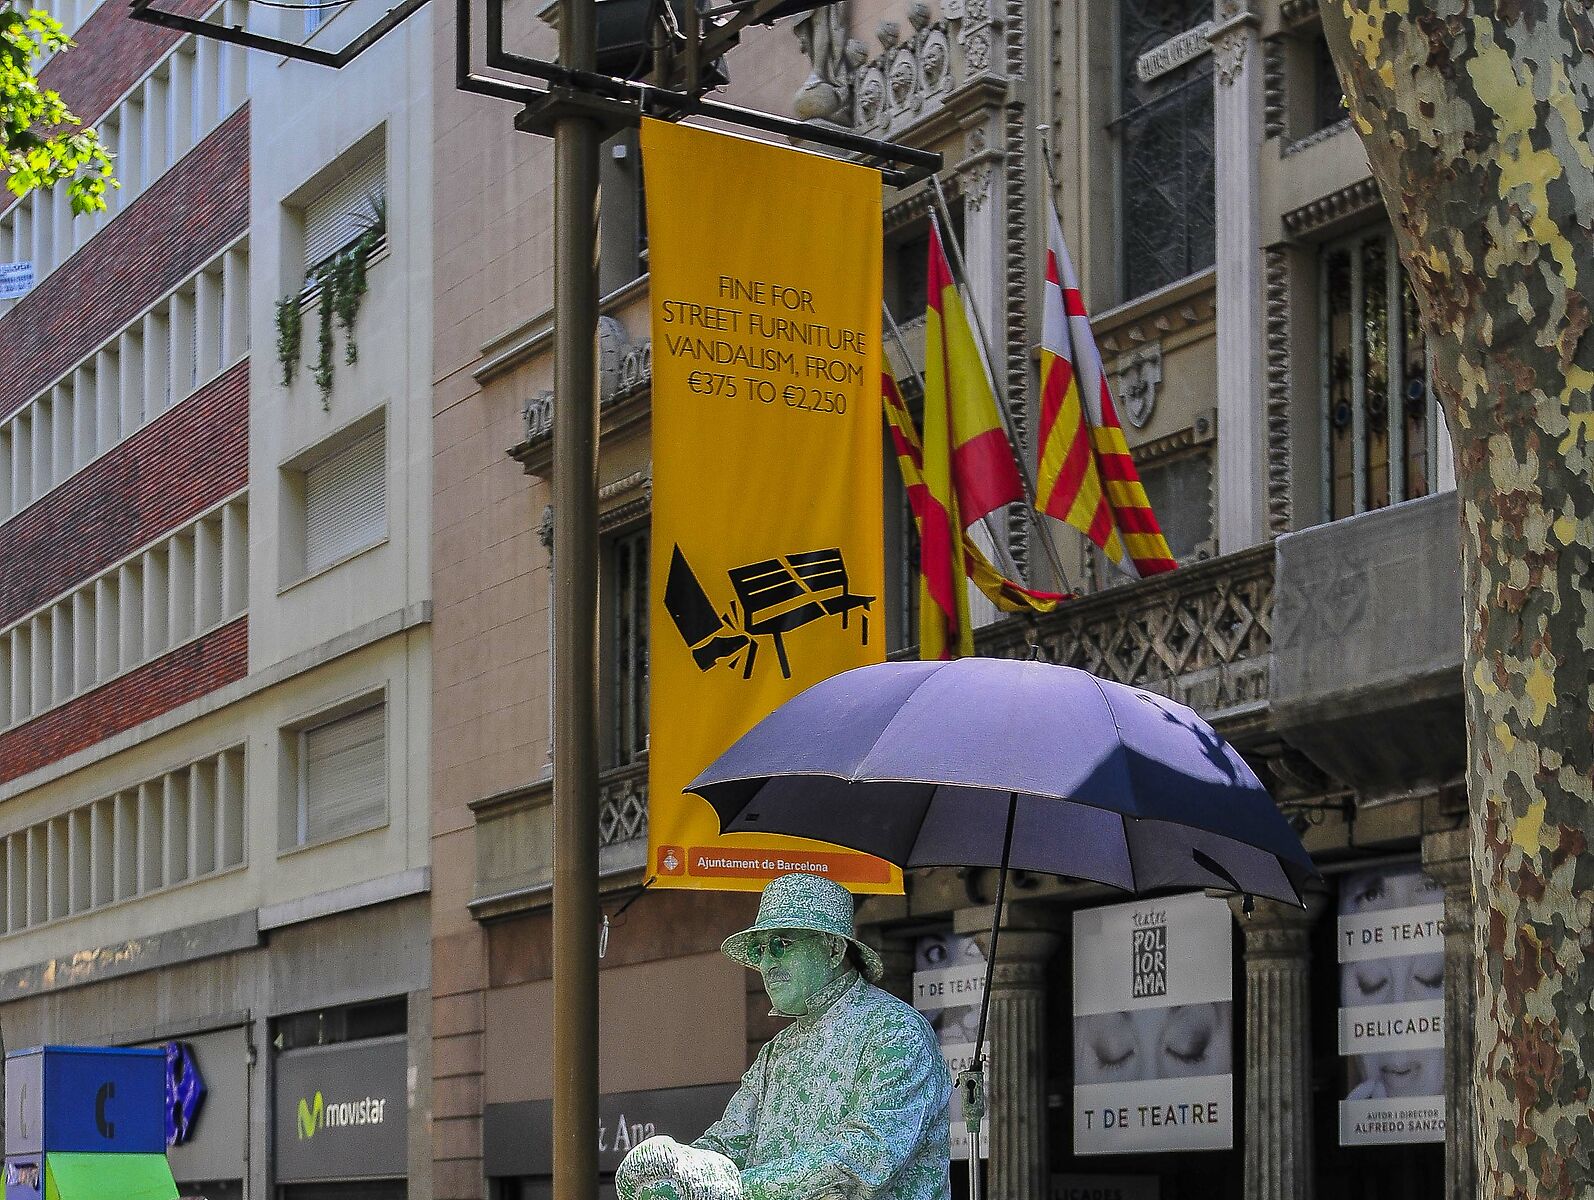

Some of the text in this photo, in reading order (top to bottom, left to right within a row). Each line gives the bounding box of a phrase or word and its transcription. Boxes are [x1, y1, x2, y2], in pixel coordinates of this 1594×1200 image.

[719, 276, 816, 314] FINE FOR
[662, 301, 867, 356] STREET FURNITURE
[806, 356, 864, 386] FROM
[687, 371, 738, 398] €375
[744, 379, 777, 403] TO
[697, 856, 829, 873] Ajuntament de Barcelona
[1135, 930, 1166, 951] POL
[1345, 930, 1354, 946] T
[1362, 927, 1383, 944] DE
[1135, 951, 1166, 974] IOR
[918, 984, 925, 997] T
[929, 983, 944, 995] DE
[1134, 973, 1166, 996] AMA
[1354, 1016, 1441, 1038] DELICADE
[325, 1096, 387, 1128] movistar
[1085, 1102, 1218, 1129] T DE TEATRE
[1354, 1121, 1405, 1133] ALFREDO
